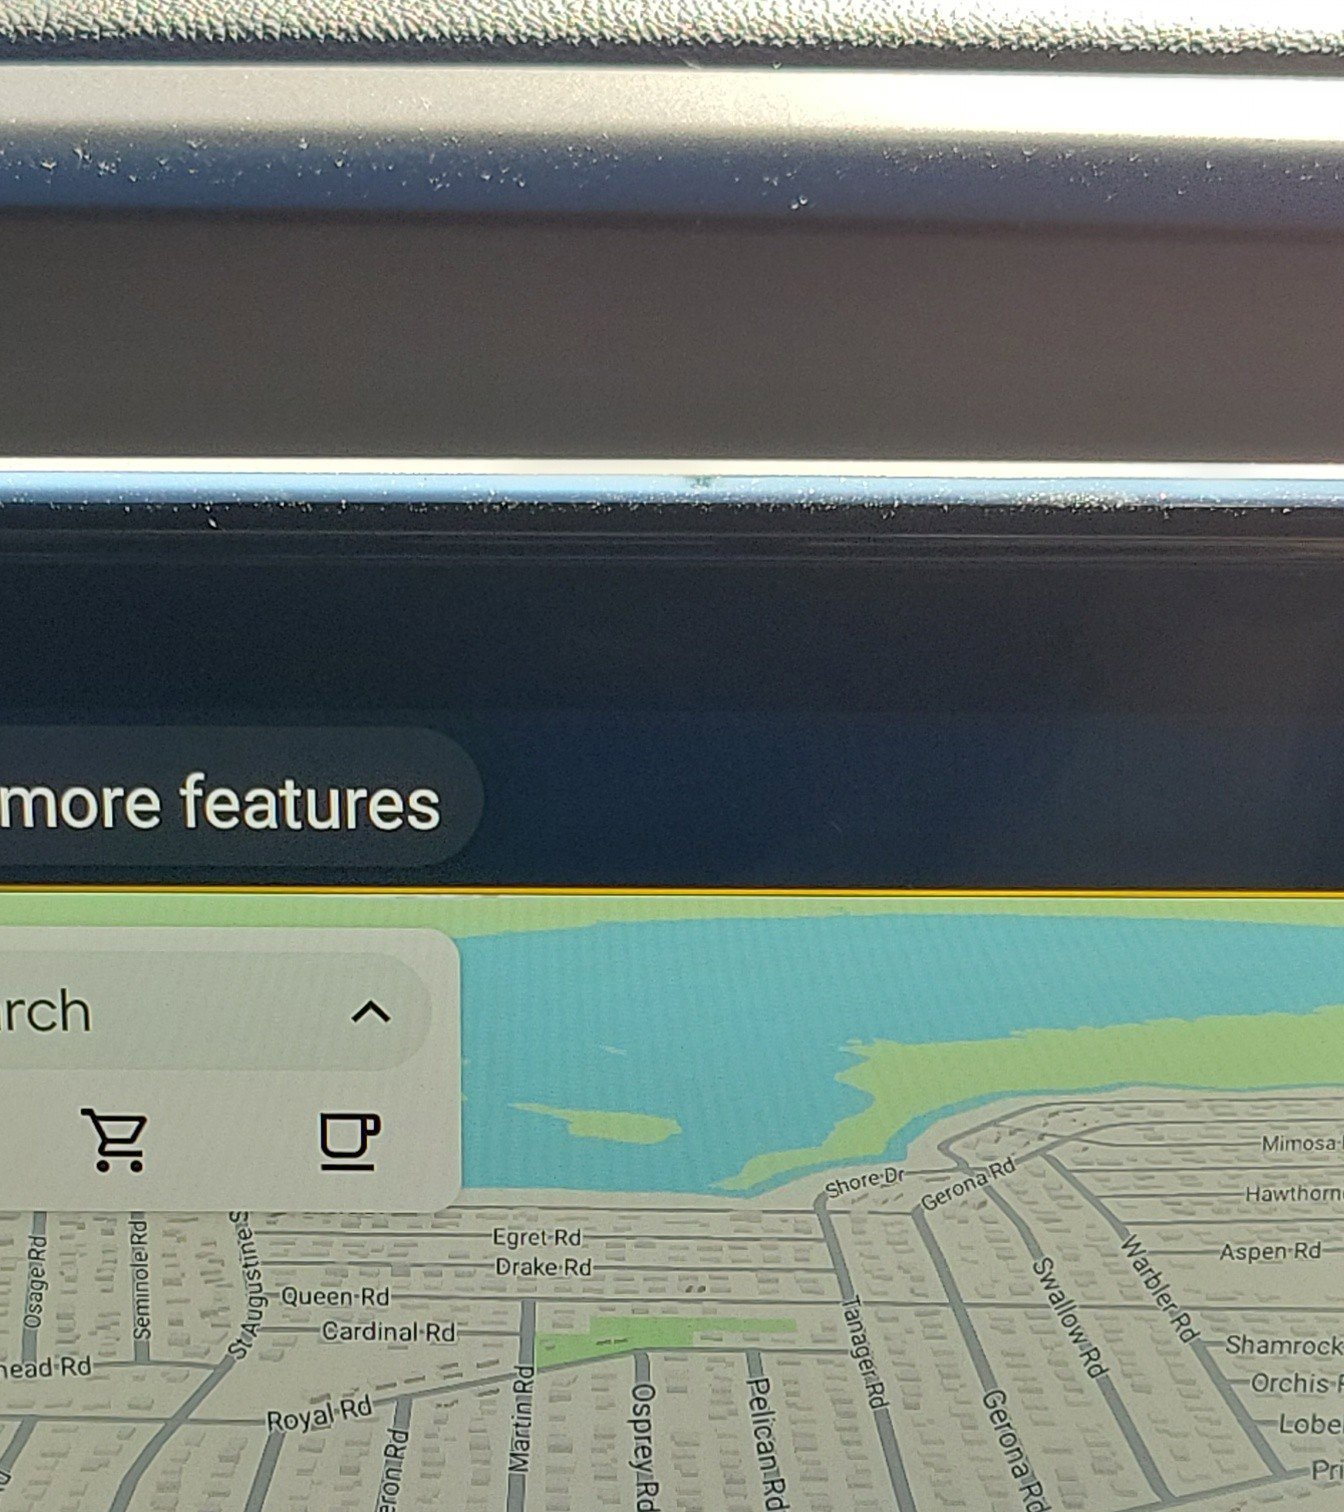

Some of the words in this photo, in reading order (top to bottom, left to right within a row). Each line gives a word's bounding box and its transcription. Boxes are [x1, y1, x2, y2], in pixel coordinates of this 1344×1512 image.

[0, 784, 162, 829] more
[178, 772, 441, 830] features
[1261, 1133, 1336, 1153] Mimosa
[825, 1175, 881, 1199] Shore
[885, 1167, 904, 1183] Dr
[921, 1173, 989, 1211] Gerona
[989, 1157, 1017, 1180] Rd
[28, 1235, 48, 1263] Rd
[131, 1219, 148, 1246] Rd
[493, 1228, 548, 1251] Egret
[554, 1229, 582, 1247] Rd
[496, 1258, 557, 1276] Drake
[564, 1258, 592, 1276] Rd
[1219, 1242, 1287, 1265] Aspen
[1292, 1242, 1322, 1260] Rd
[23, 1265, 47, 1329] Osage
[133, 1248, 152, 1340] Seminole
[237, 1228, 269, 1338] Augustine
[280, 1286, 353, 1308] Queen
[361, 1287, 390, 1307] Rd
[1121, 1234, 1178, 1314] Warbler
[1168, 1311, 1200, 1345] Rd
[322, 1321, 420, 1342] Cardinal
[425, 1323, 456, 1343] Rd
[1033, 1256, 1089, 1349] Swallow
[1079, 1344, 1109, 1380] Rd
[228, 1338, 253, 1360] St
[842, 1294, 877, 1377] Tanager
[865, 1381, 890, 1409] Rd
[61, 1356, 92, 1377] Rd
[513, 1363, 535, 1393] Rd
[1251, 1372, 1332, 1395] Orchis
[267, 1405, 334, 1433] Royal
[340, 1398, 373, 1421] Rd
[628, 1383, 657, 1475] Osprey
[747, 1377, 780, 1472] Pelican
[386, 1428, 409, 1459] Rd
[509, 1398, 533, 1473] Martin
[982, 1389, 1032, 1480] Gerona
[763, 1477, 789, 1512] Rd
